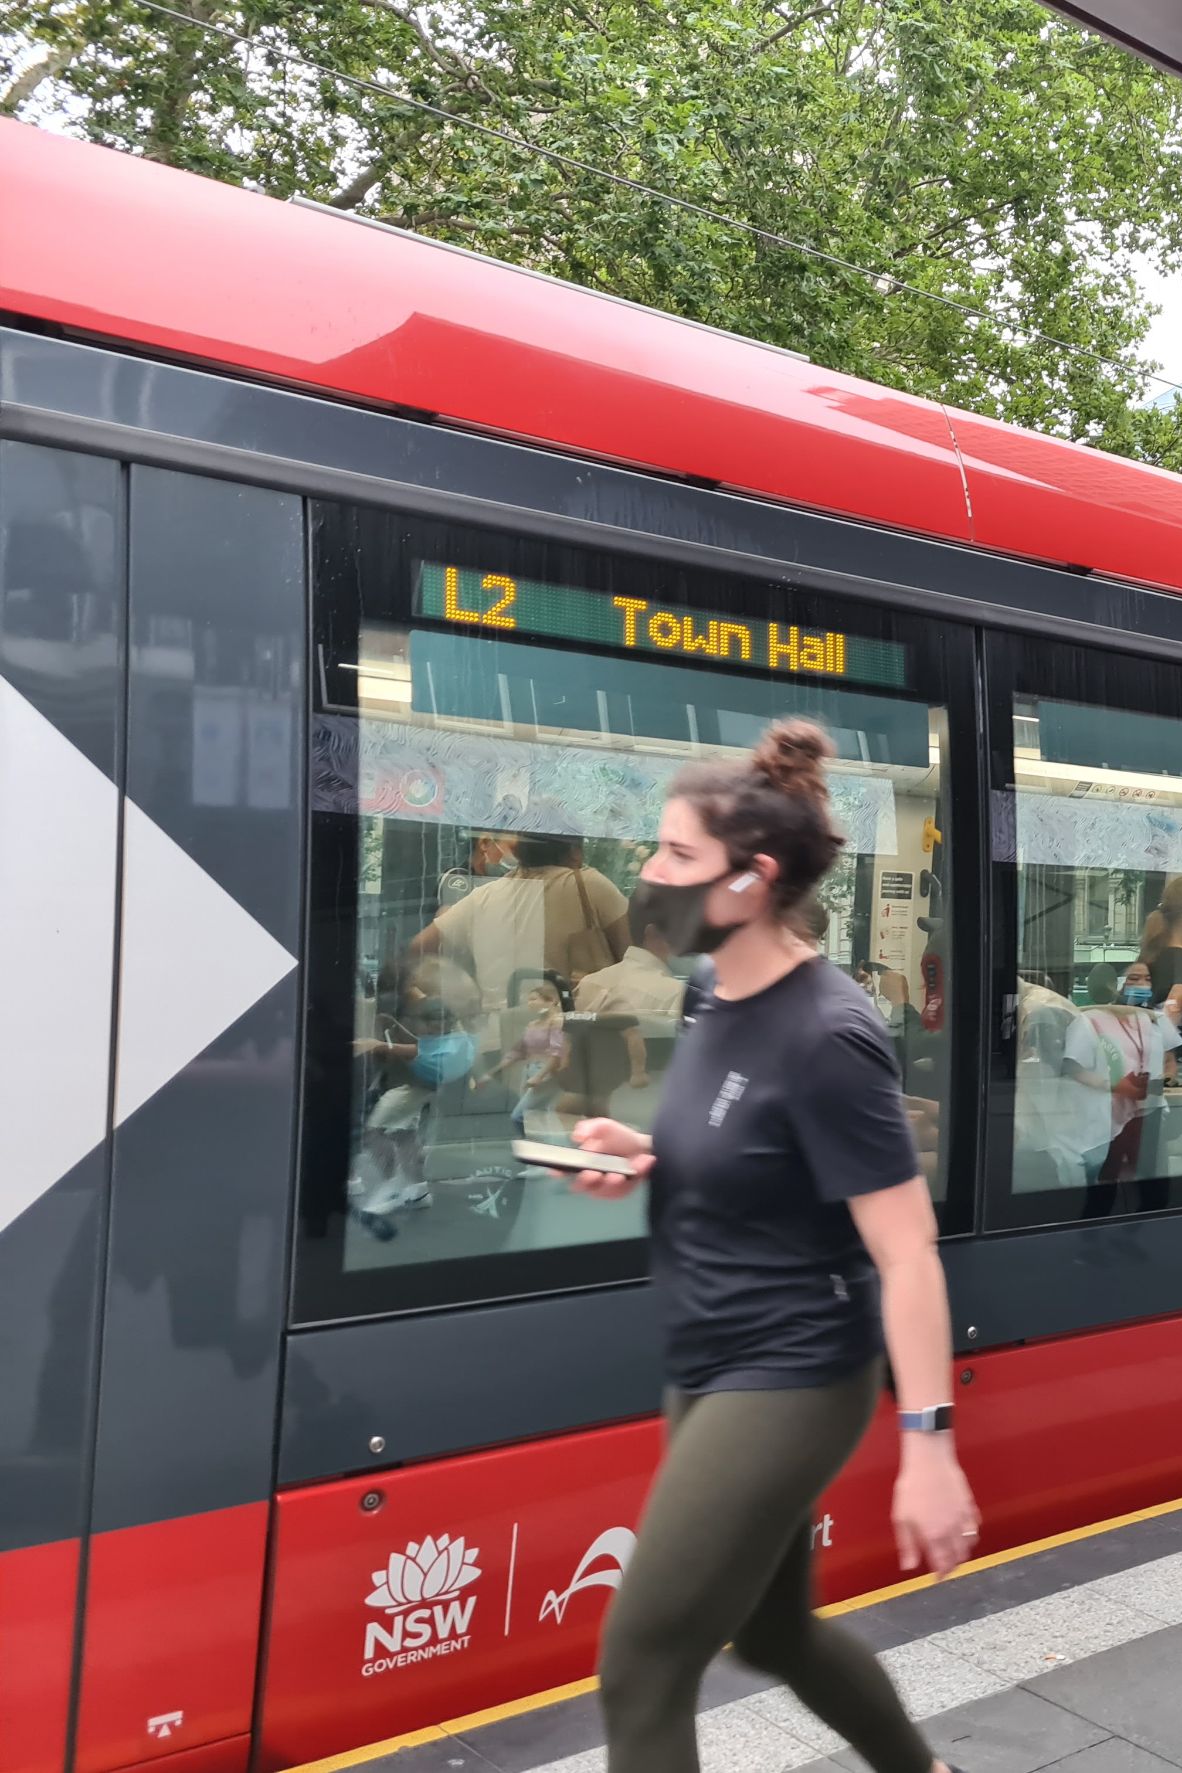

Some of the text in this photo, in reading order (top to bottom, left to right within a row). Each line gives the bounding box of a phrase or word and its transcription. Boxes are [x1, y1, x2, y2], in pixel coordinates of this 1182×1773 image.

[444, 566, 847, 675] L2 Town Hall
[361, 1636, 471, 1676] GOVERNMENT
[364, 1596, 477, 1660] NSW
